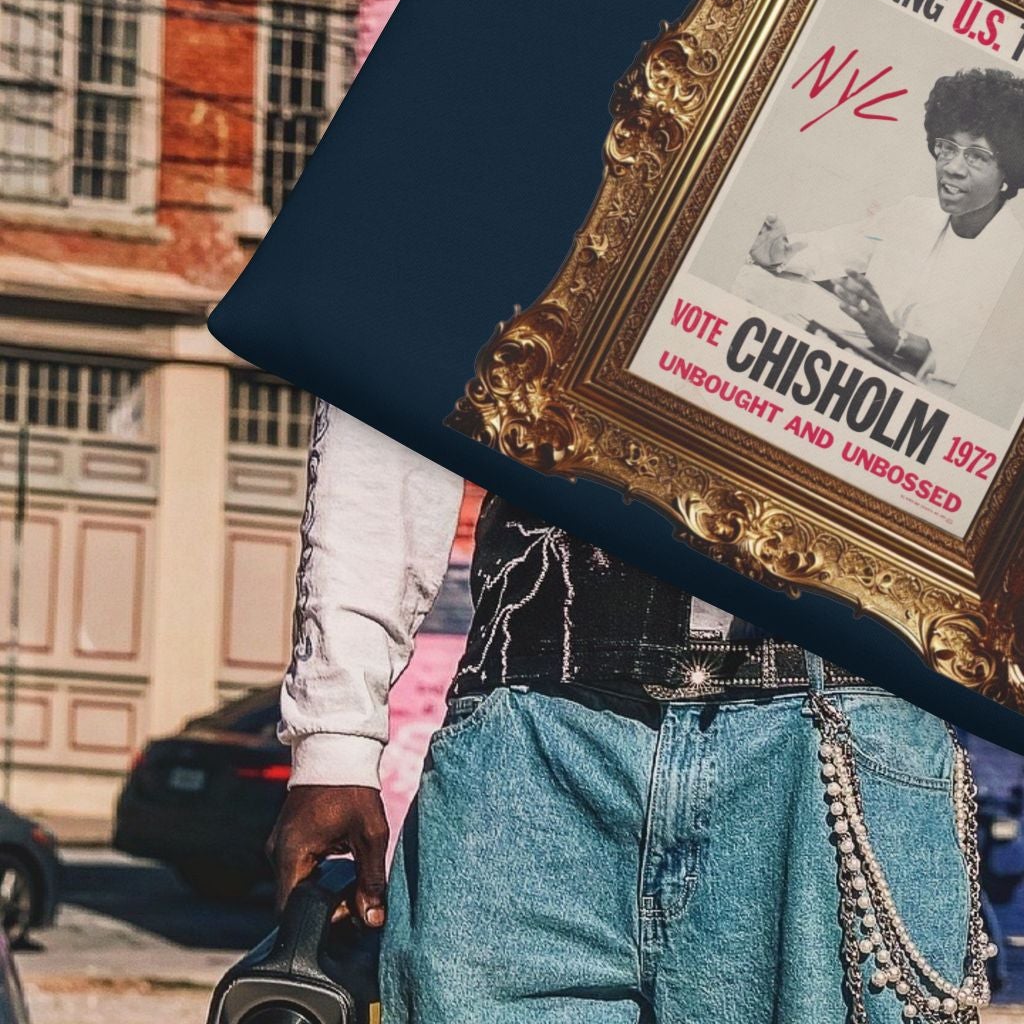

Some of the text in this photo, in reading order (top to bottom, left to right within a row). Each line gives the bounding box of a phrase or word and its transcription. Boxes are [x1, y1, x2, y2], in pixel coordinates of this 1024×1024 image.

[791, 45, 908, 133] NYC
[658, 350, 784, 423] UNBOUGHT
[783, 415, 834, 449] AND
[841, 441, 962, 513] UNBOSSED
[670, 298, 997, 480] VOTE CHISHOLM 1972
